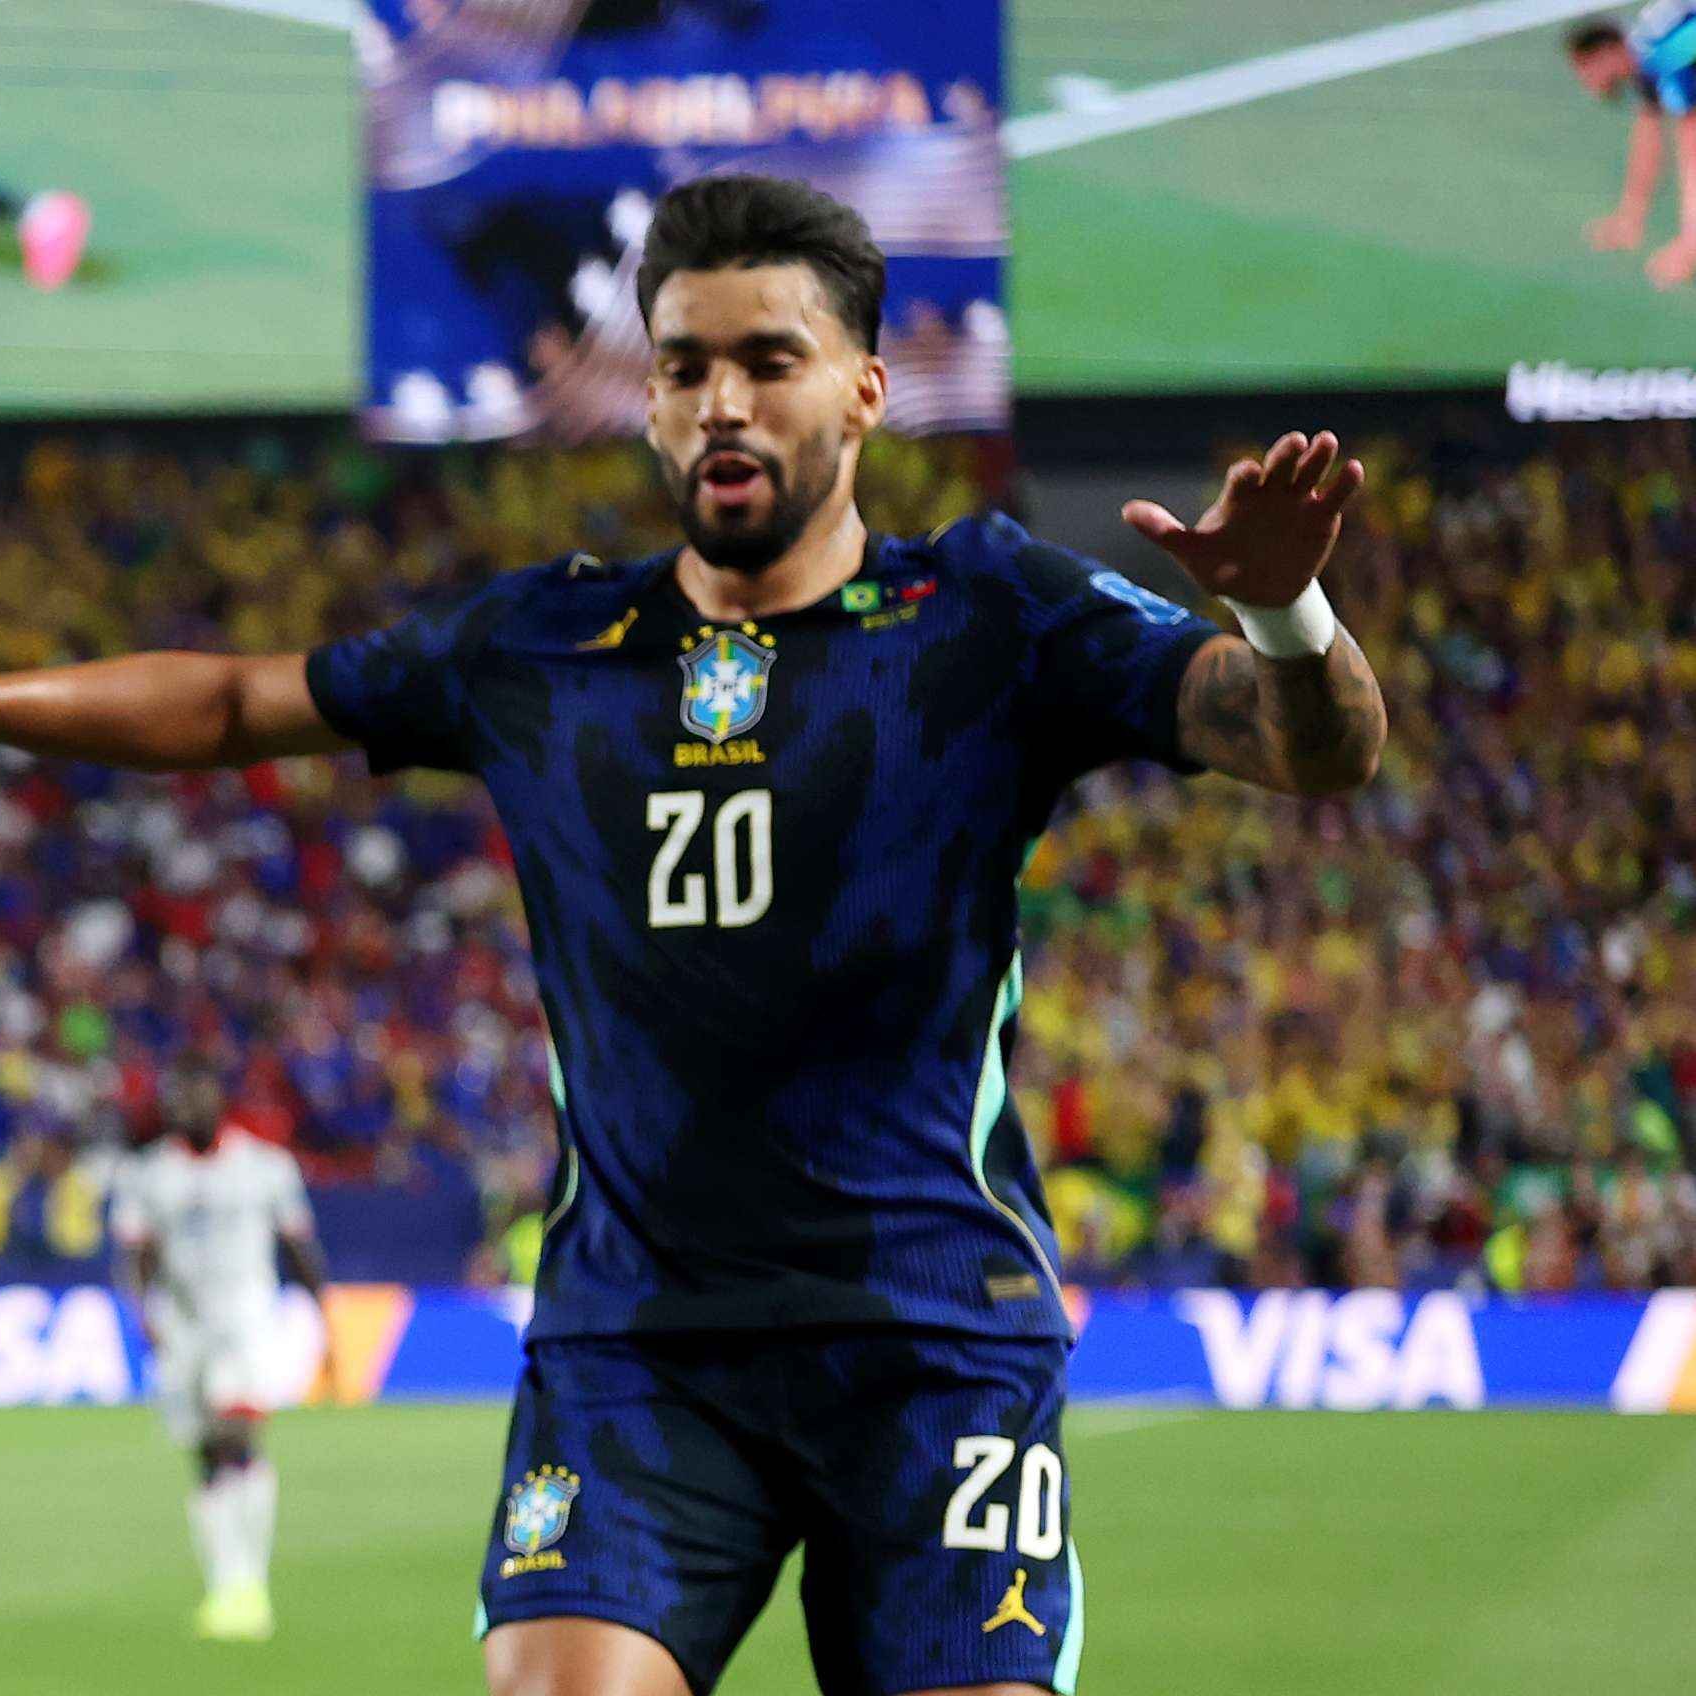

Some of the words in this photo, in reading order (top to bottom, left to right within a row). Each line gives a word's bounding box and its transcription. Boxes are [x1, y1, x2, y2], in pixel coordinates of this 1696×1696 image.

[673, 739, 766, 768] BRASIL
[646, 788, 774, 928] 20
[1177, 1287, 1487, 1411] VISA
[942, 1434, 1062, 1561] 20
